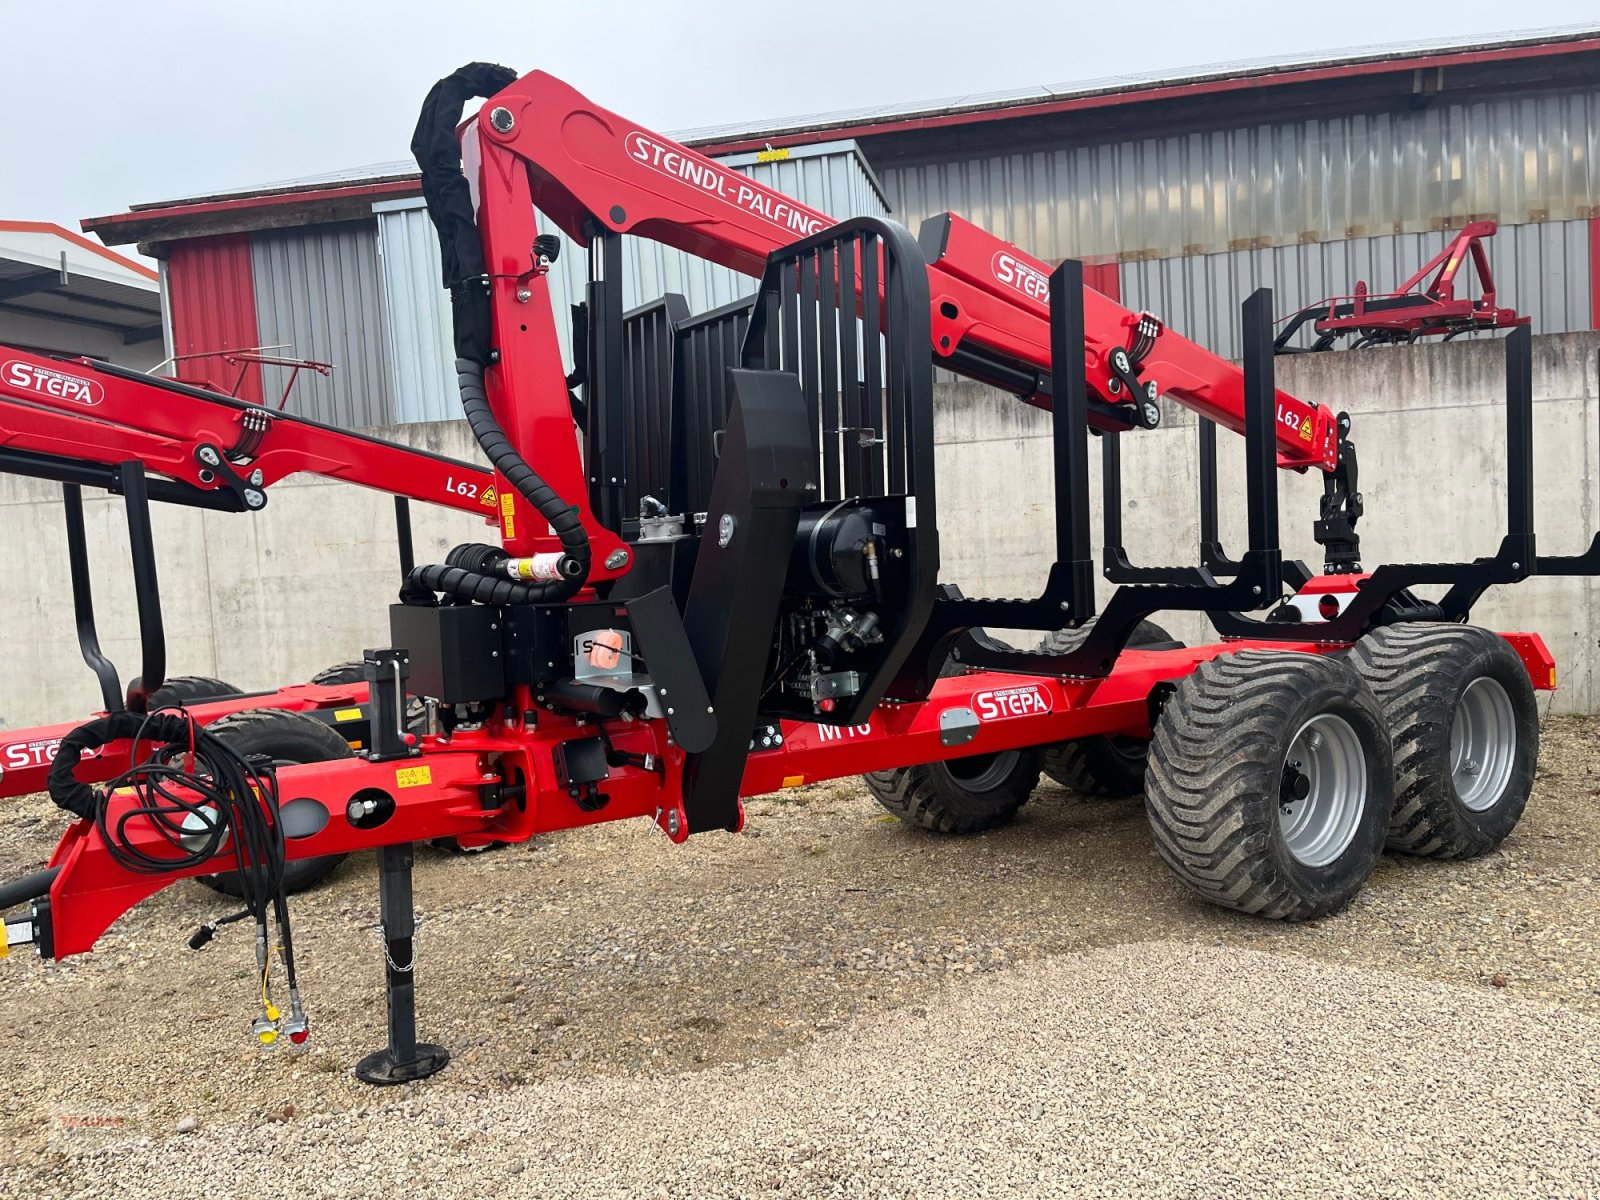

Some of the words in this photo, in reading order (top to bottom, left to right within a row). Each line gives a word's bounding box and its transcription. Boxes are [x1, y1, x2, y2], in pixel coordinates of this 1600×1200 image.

[633, 137, 829, 236] STEINDL-PALFING
[9, 363, 92, 404] STEPA
[1277, 404, 1299, 431] L62
[446, 477, 477, 499] L62
[977, 692, 1048, 719] STEPA
